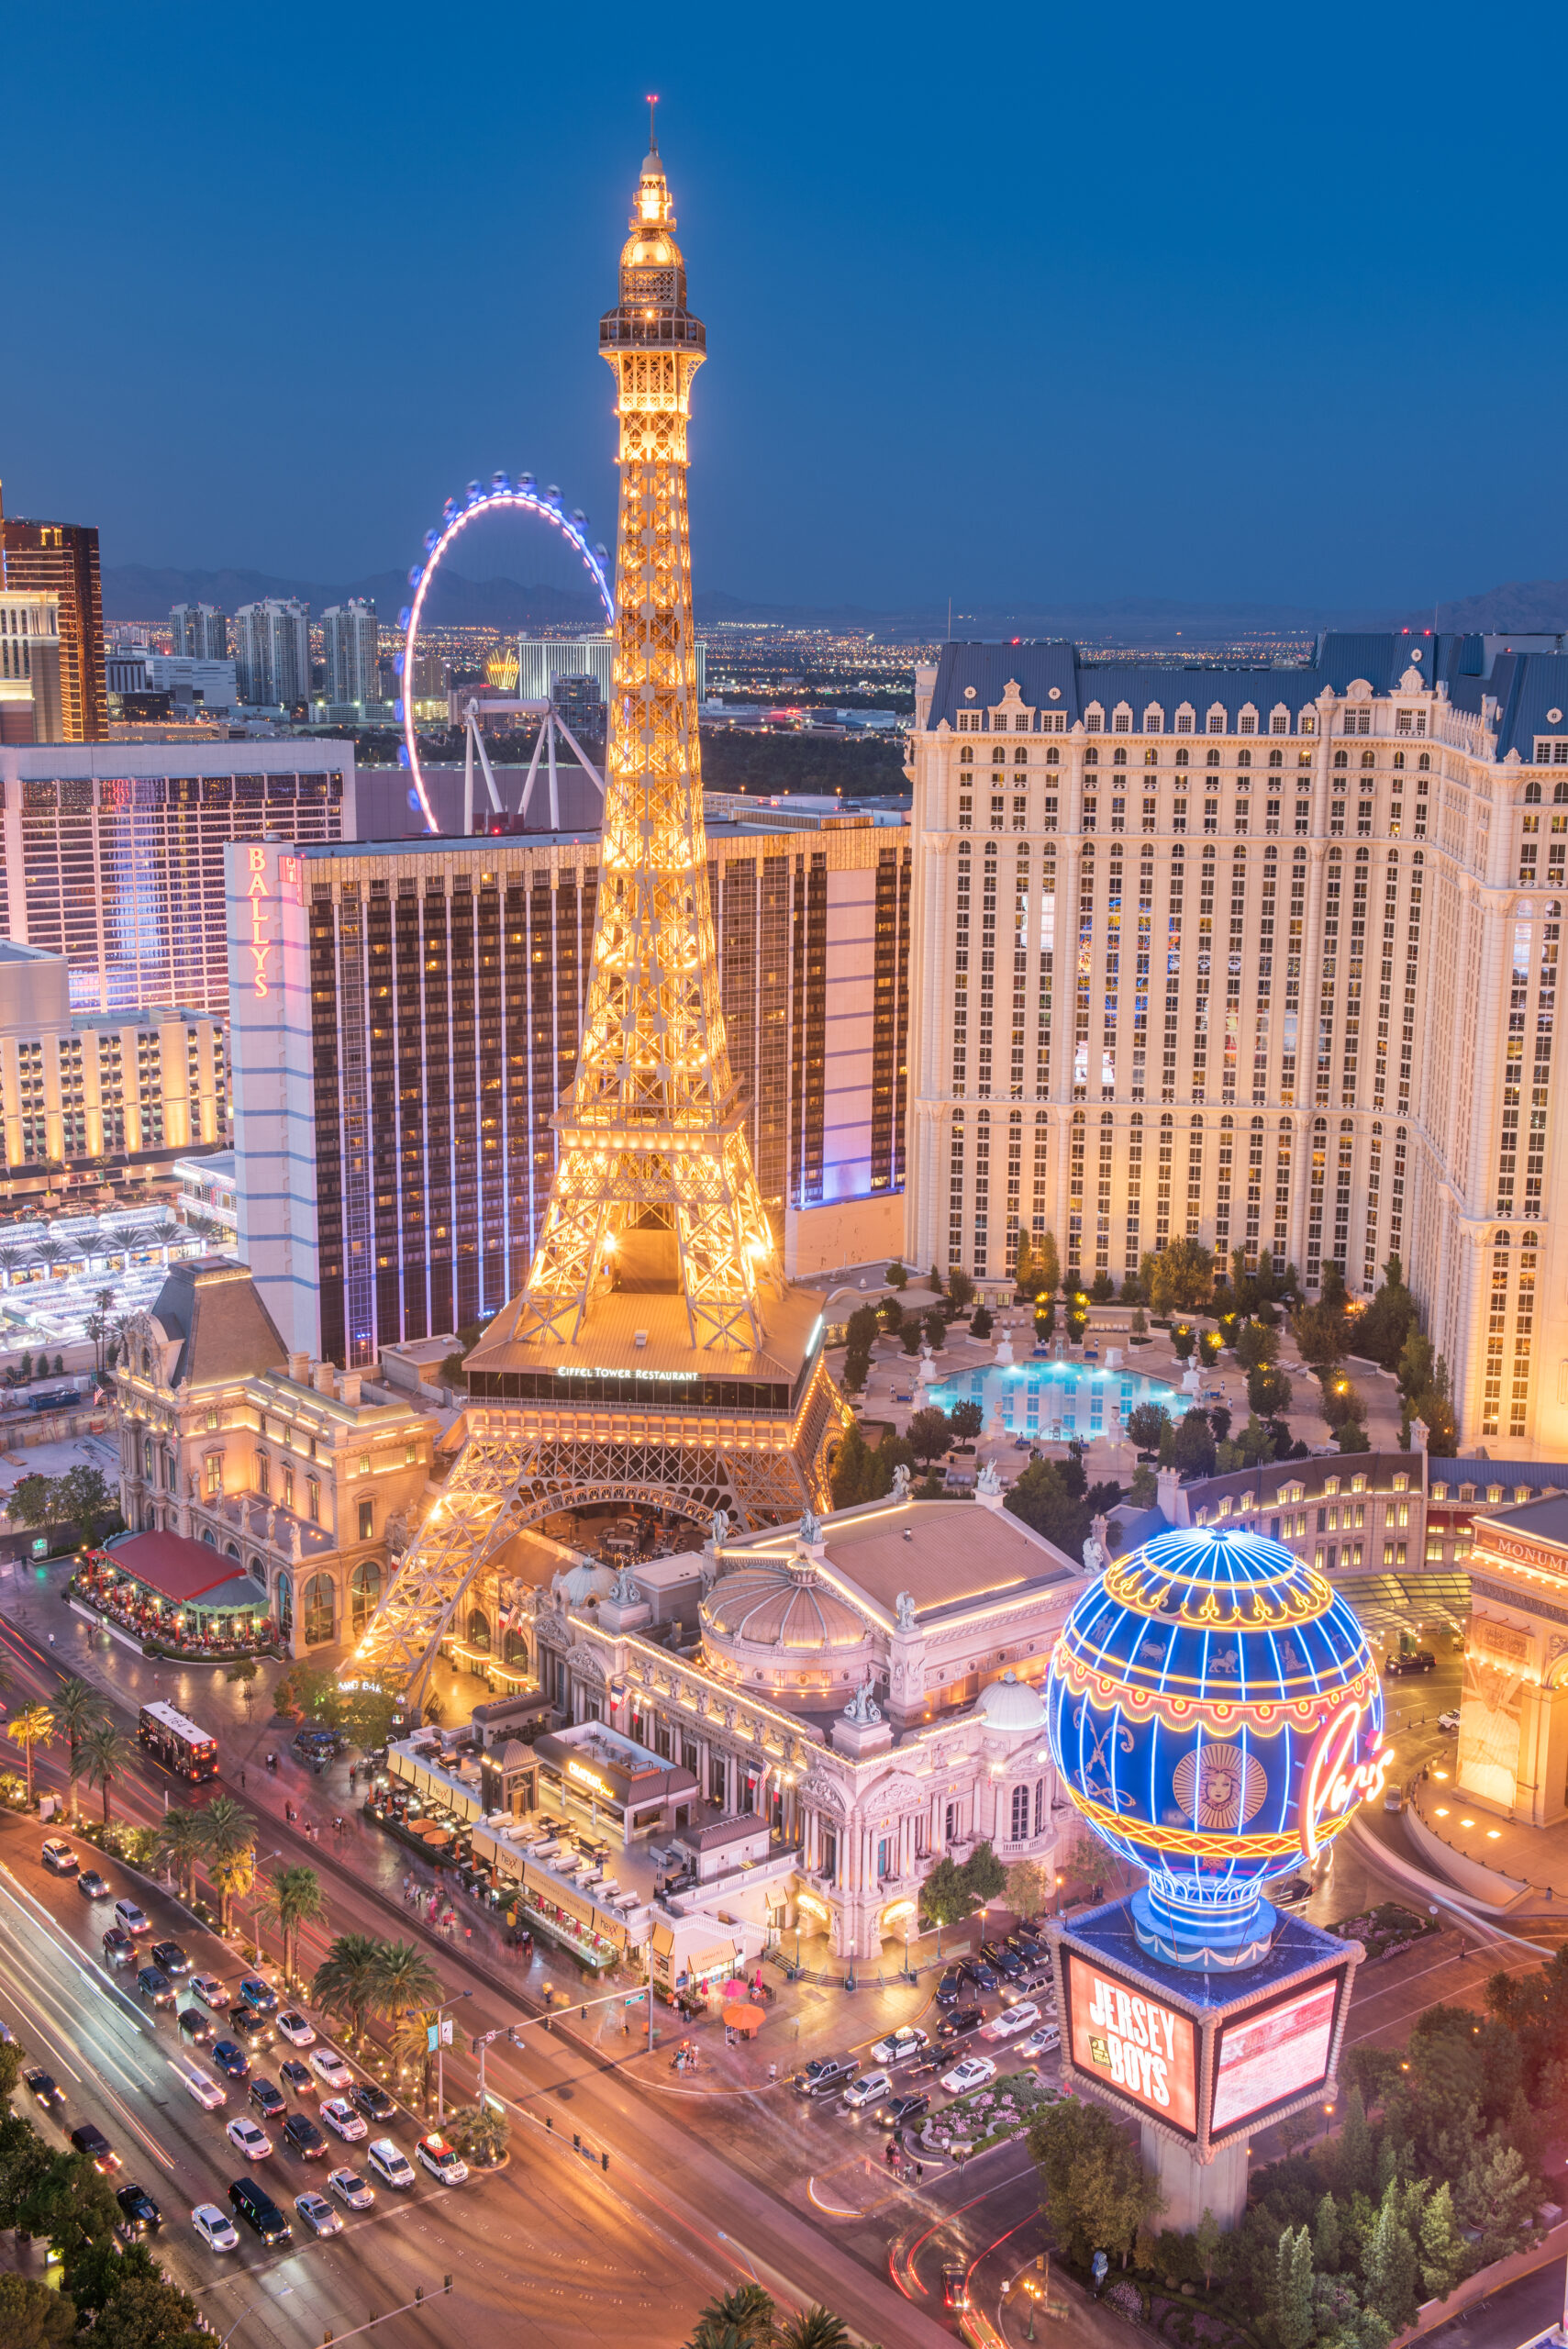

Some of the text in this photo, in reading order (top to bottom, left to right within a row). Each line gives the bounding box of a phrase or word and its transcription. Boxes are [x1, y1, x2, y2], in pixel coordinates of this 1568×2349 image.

[1300, 1701, 1396, 1861] Paris
[1089, 1977, 1175, 2062] JERSEY
[1106, 2032, 1171, 2107] BOYS
